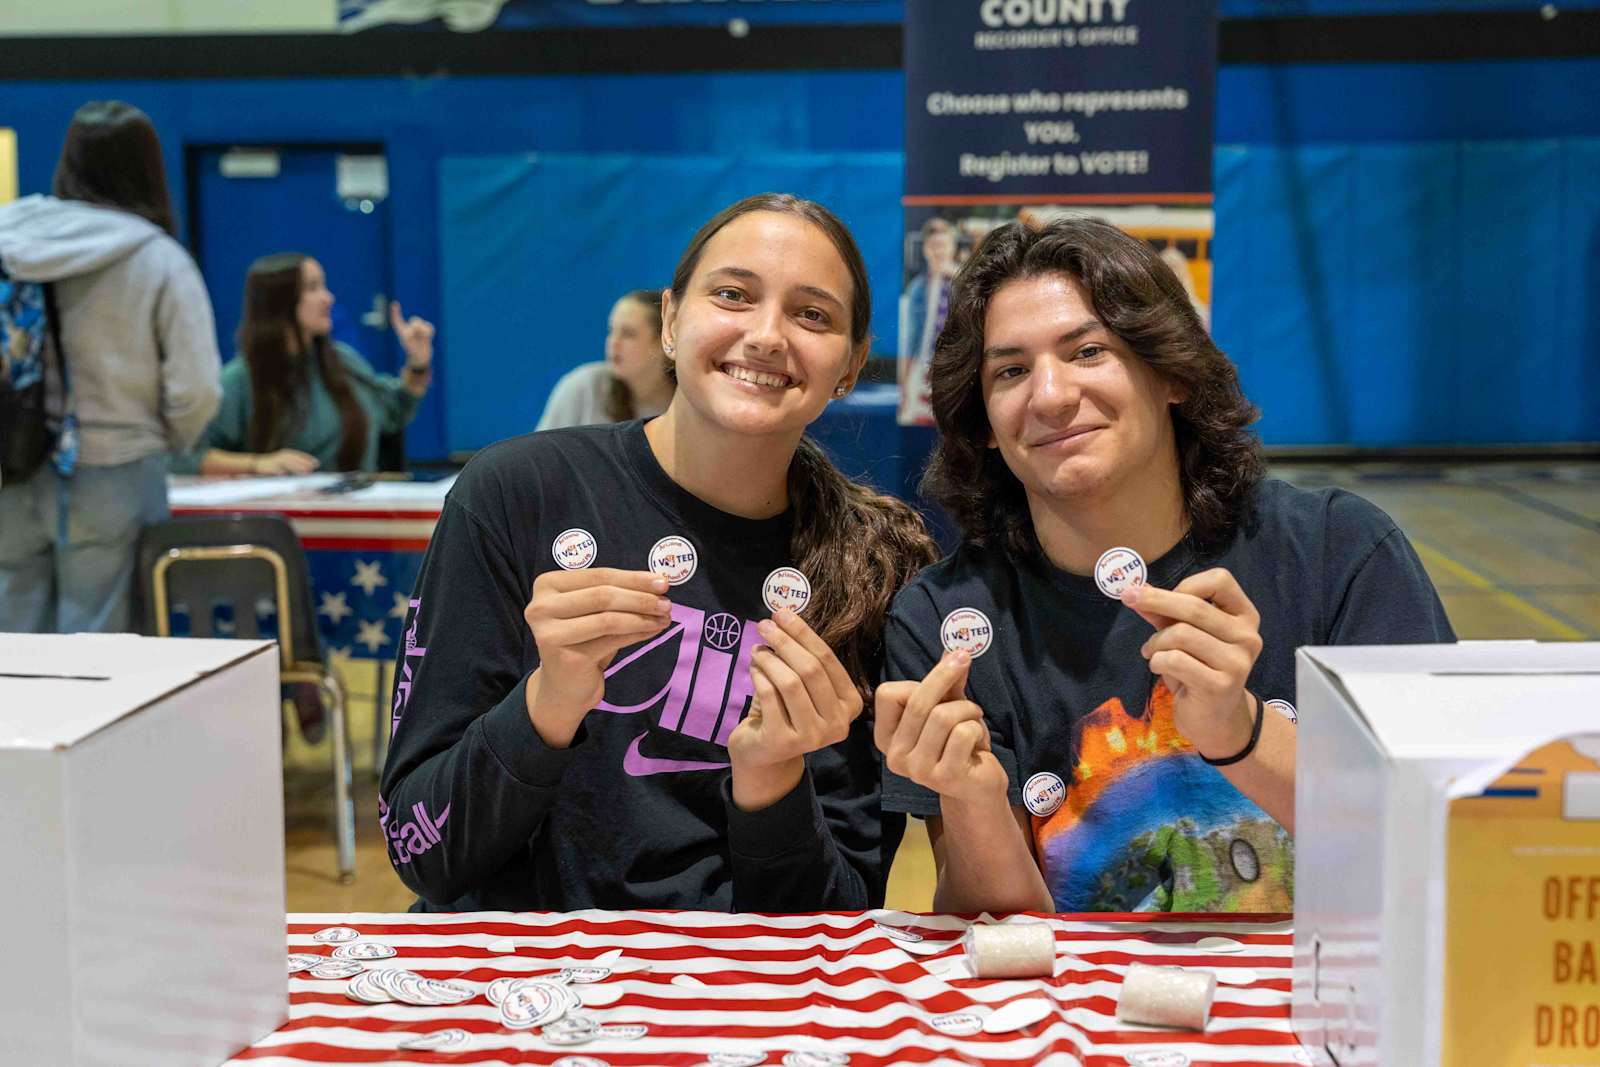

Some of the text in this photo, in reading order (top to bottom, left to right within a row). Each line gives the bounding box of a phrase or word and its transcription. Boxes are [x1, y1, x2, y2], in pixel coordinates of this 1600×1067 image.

[980, 0, 1130, 27] COUNTY
[1079, 25, 1138, 47] OFFICE
[926, 86, 1189, 117] Choose who represents
[959, 152, 1051, 182] Register
[1053, 151, 1079, 175] to
[1554, 941, 1598, 985] BA
